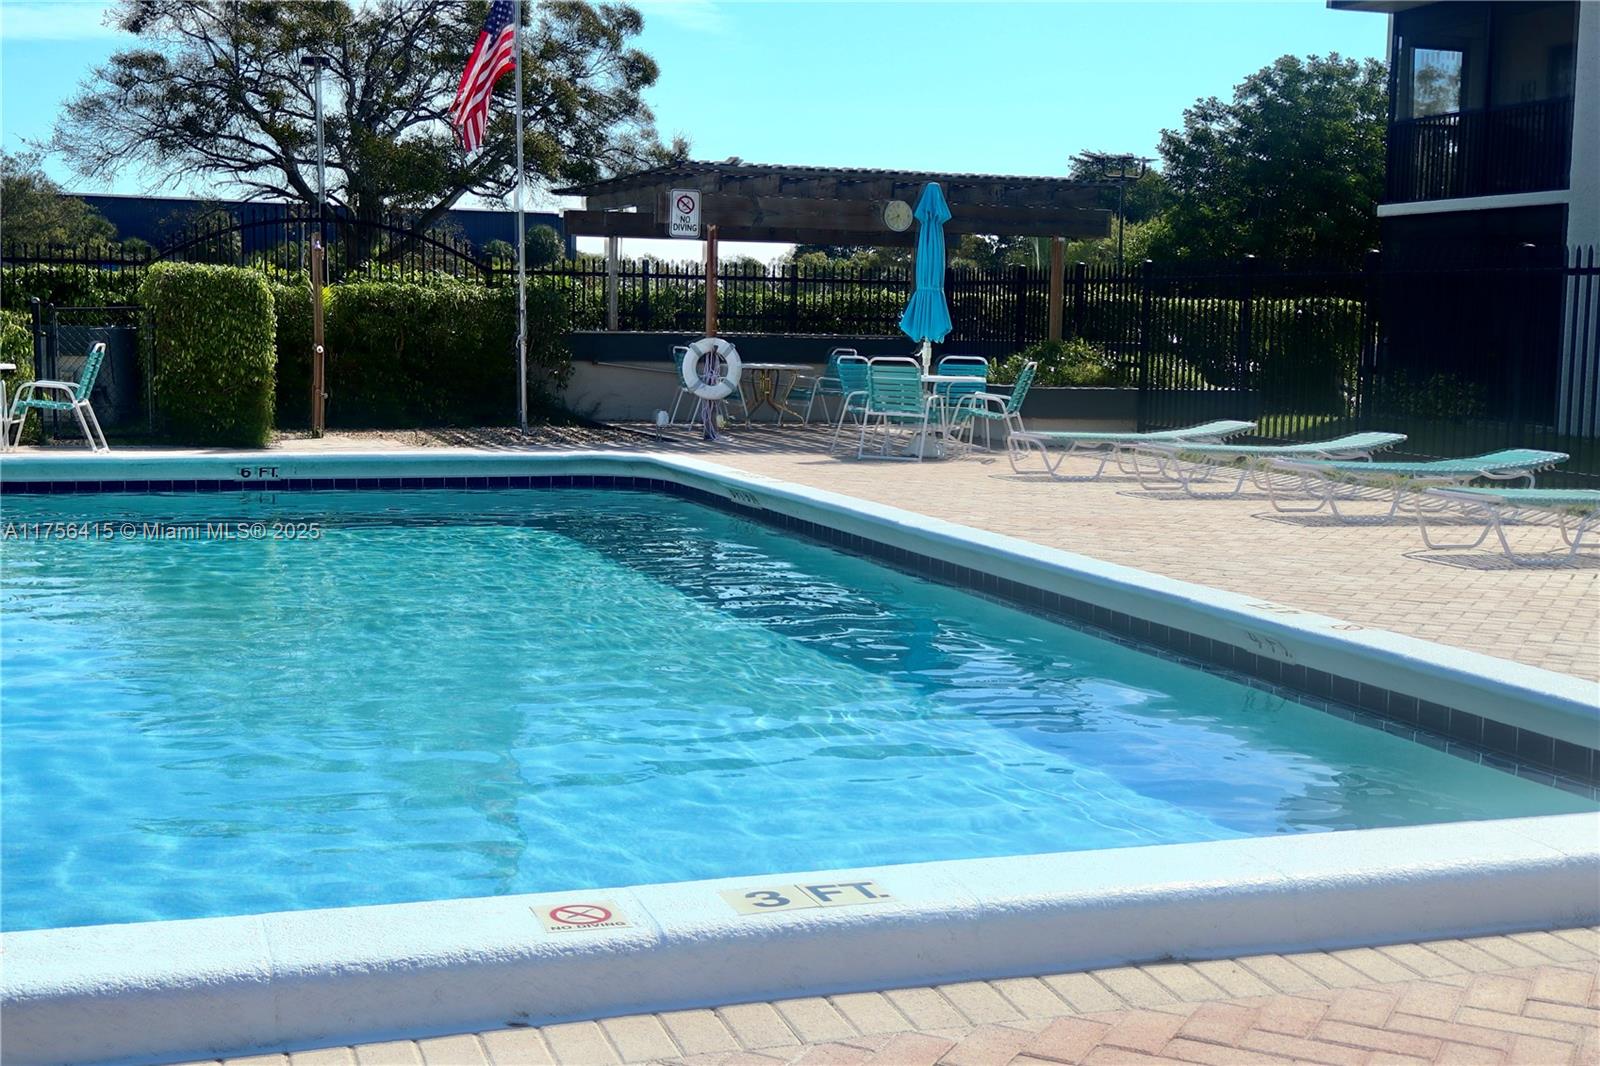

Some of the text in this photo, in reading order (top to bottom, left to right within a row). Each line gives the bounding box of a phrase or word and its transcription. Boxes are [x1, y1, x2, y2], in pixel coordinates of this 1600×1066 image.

[680, 215, 690, 223] NO
[673, 223, 697, 232] DIVING
[241, 467, 251, 478] 6
[745, 881, 889, 907] 3 FT.
